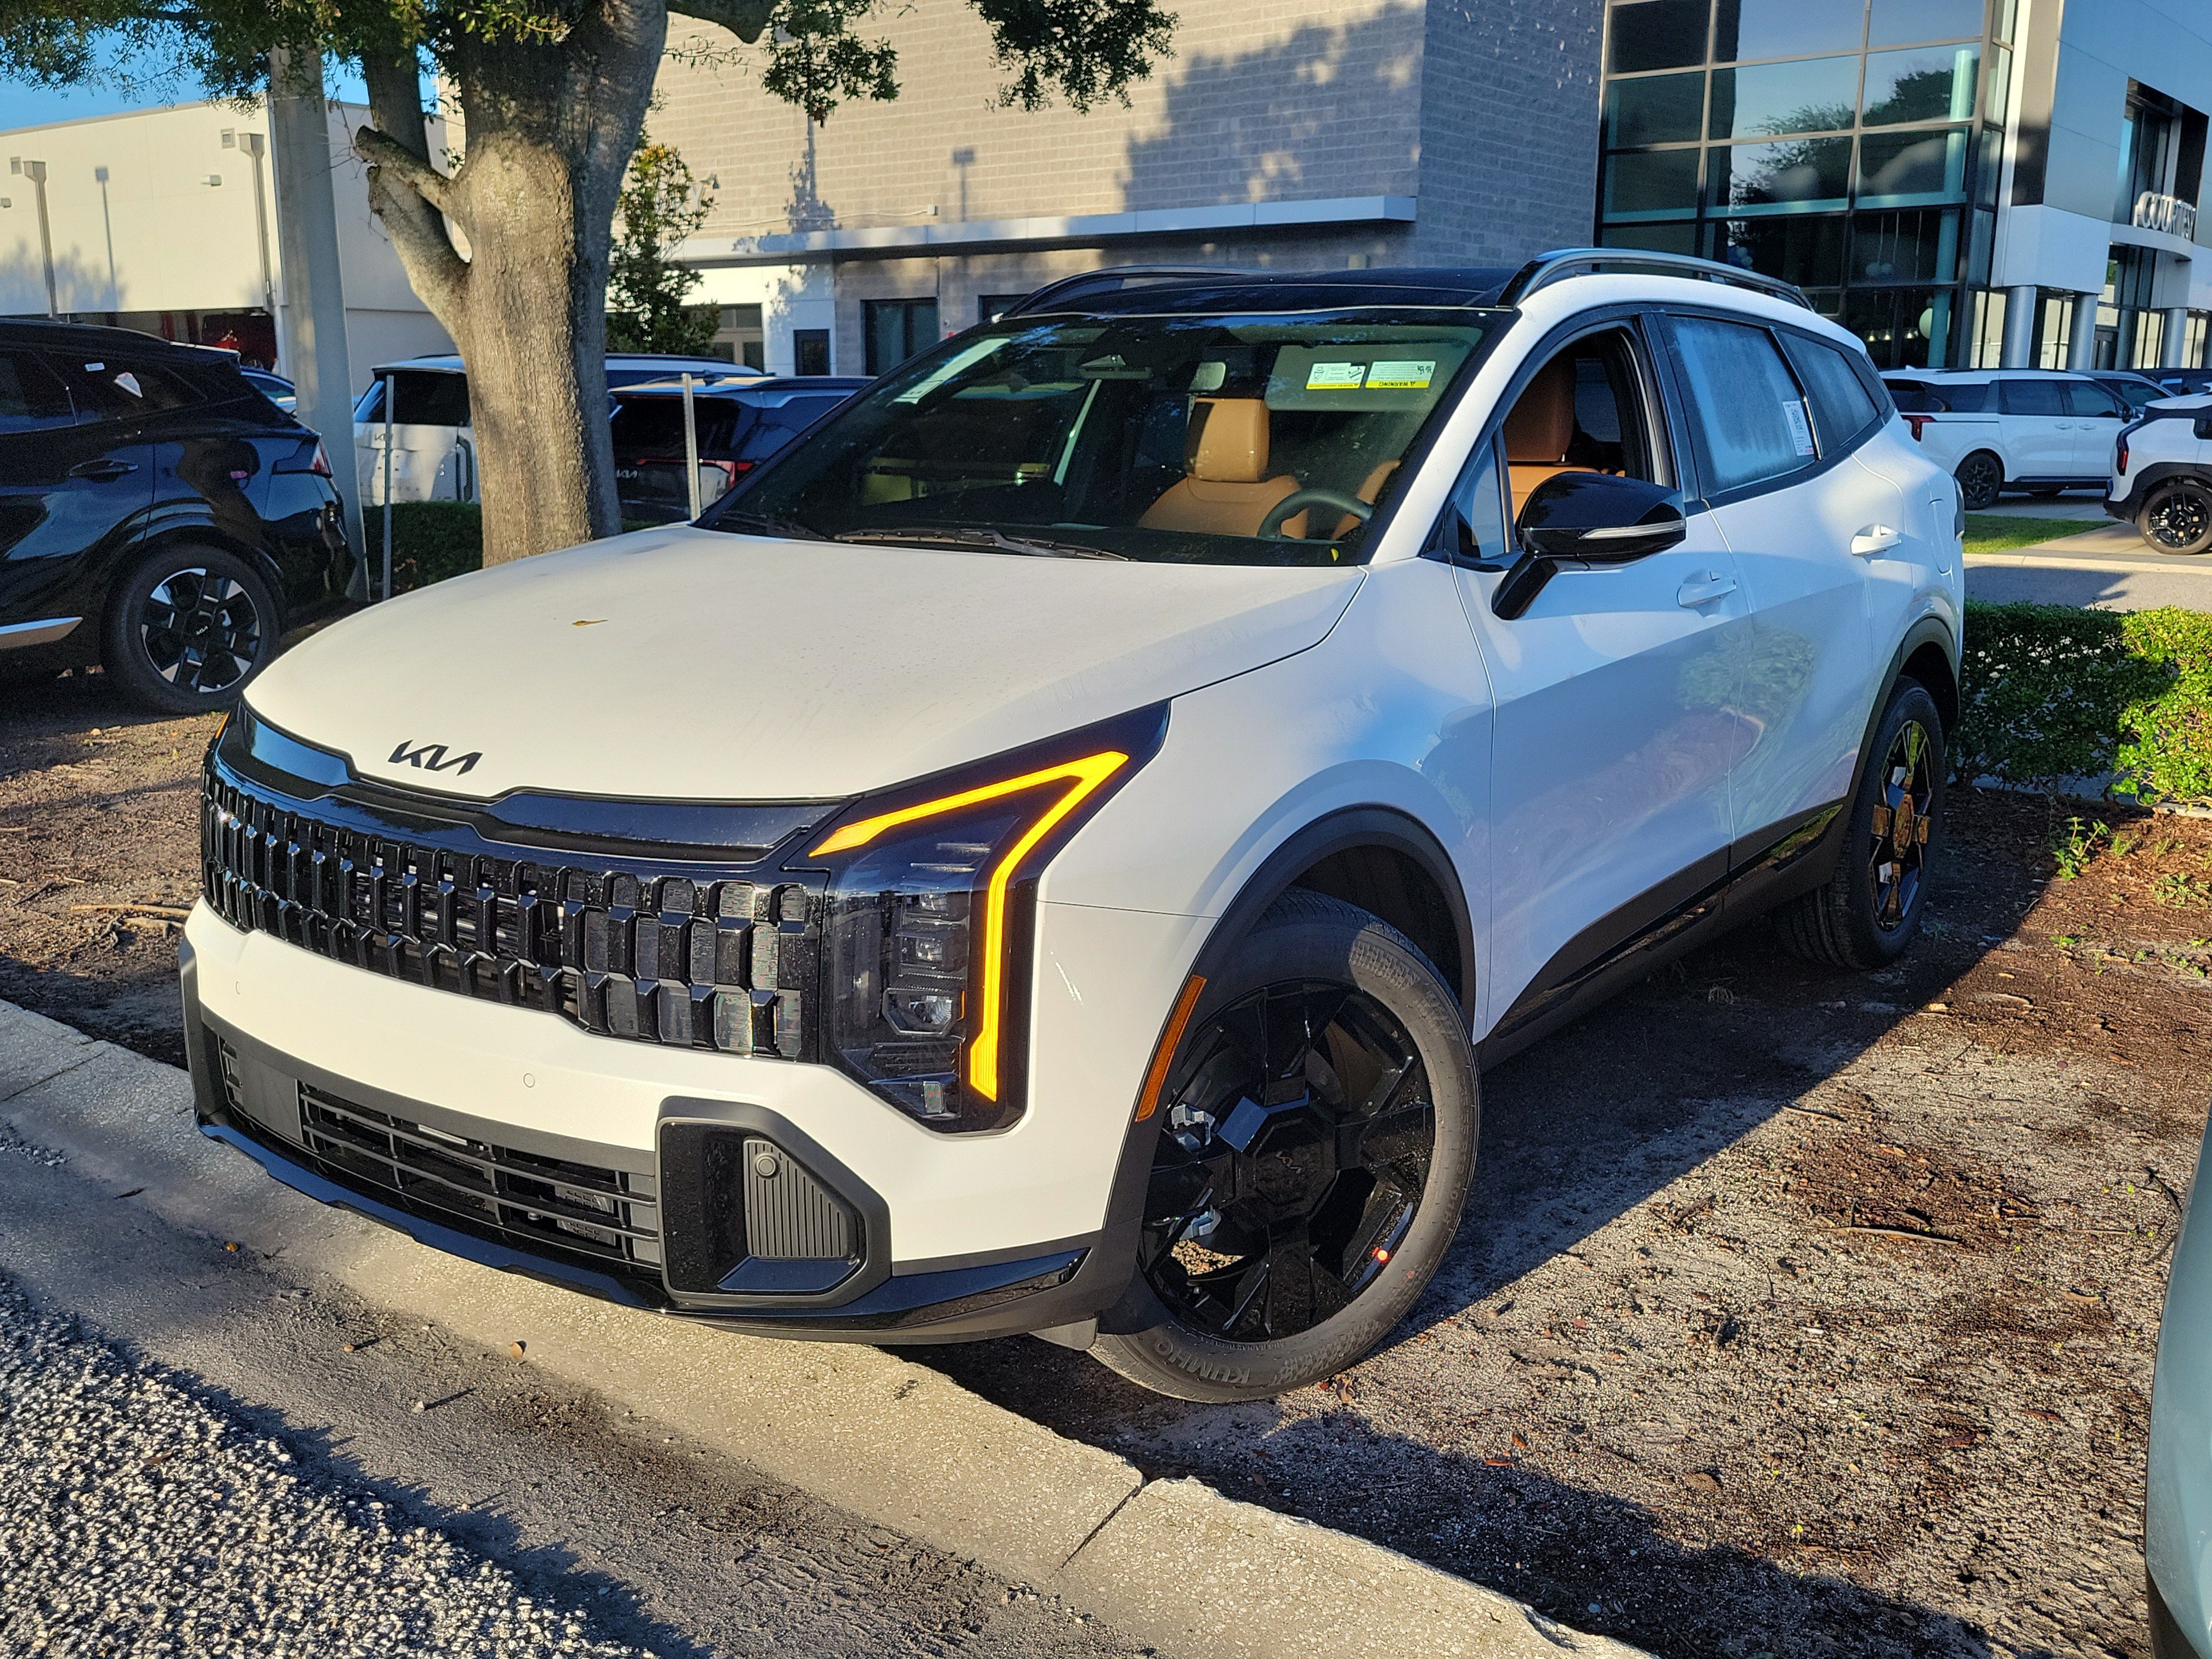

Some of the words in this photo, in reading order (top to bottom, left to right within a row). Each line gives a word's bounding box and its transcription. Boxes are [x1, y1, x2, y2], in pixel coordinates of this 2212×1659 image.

[388, 739, 483, 776] KIA
[1275, 1150, 1303, 1173] KIA
[1156, 1339, 1251, 1384] KUMHO
